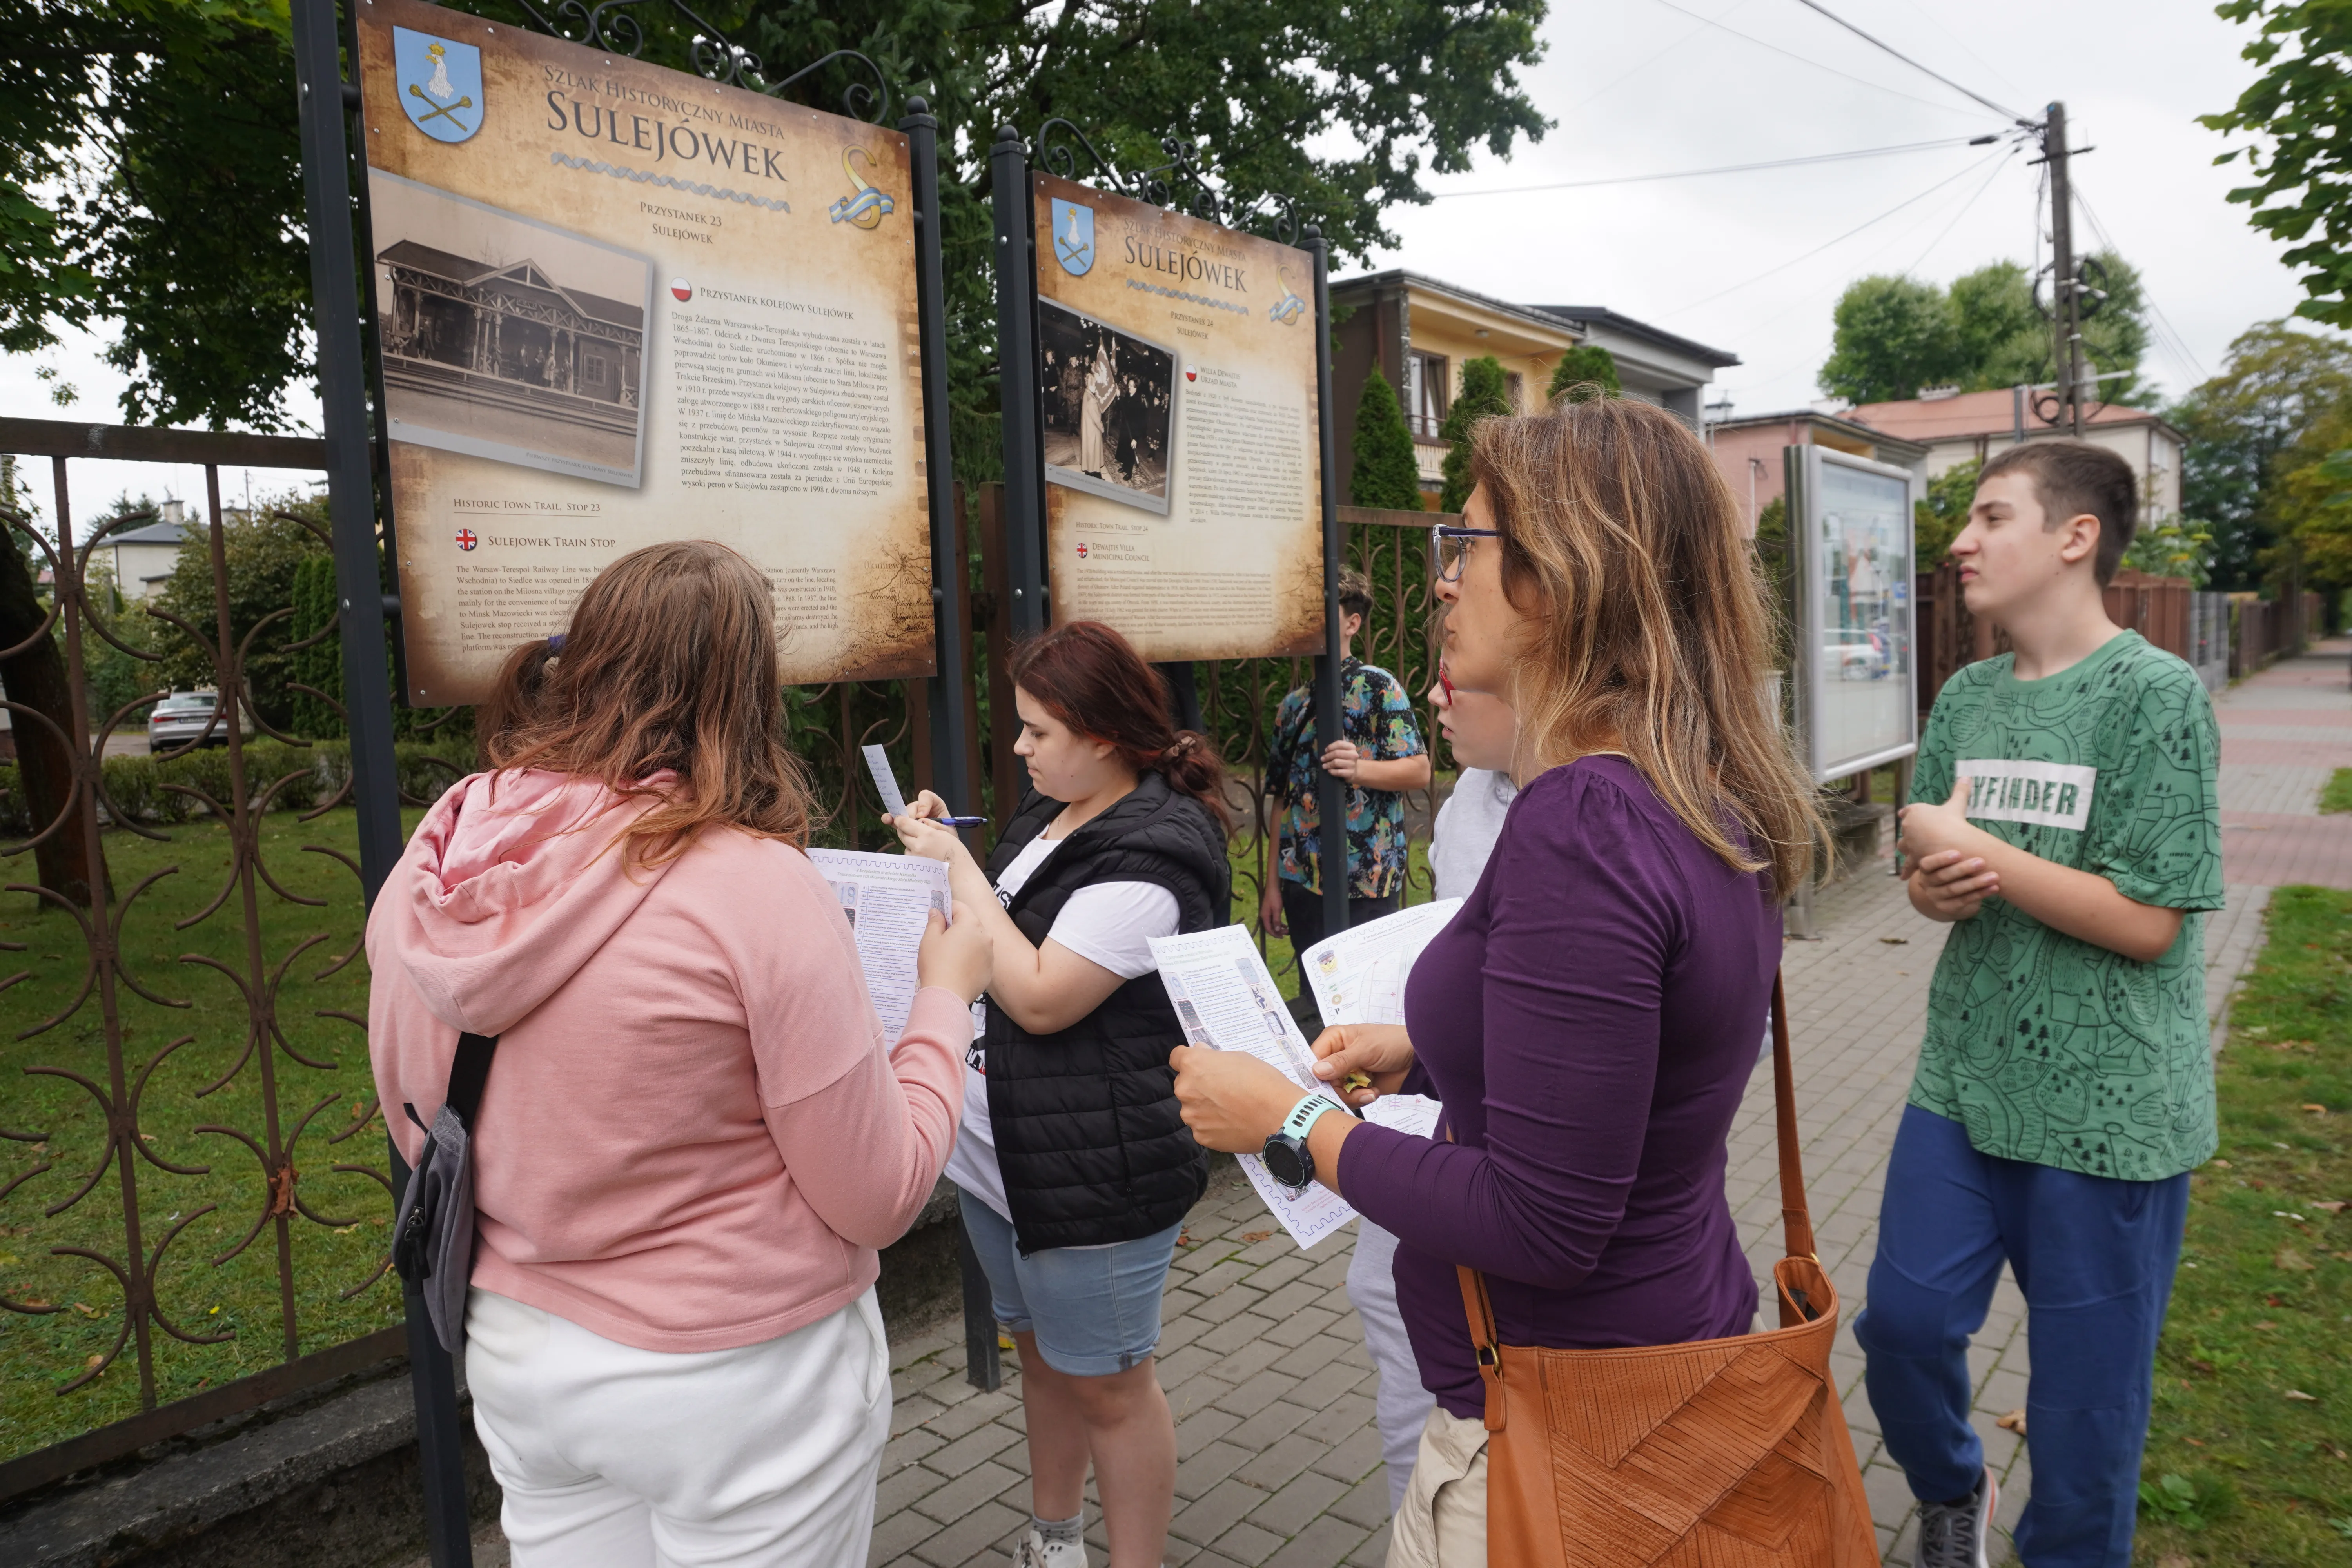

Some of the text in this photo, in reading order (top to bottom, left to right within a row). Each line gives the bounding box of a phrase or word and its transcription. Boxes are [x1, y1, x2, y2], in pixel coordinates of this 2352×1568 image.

[544, 64, 785, 140] SZLAK HISTORYCZNY MIASTA
[547, 90, 789, 181] SULEJÓWEK
[640, 201, 722, 227] PRZYSTANEK 23
[652, 223, 713, 244] SULEJÓWEK
[1124, 218, 1247, 262] SZLAK HISTORYCZNY MIASTA
[1125, 235, 1248, 293] SULEJÓWEK
[700, 287, 854, 320] PRZYSTANEK KOLEJOWY SULEJÓWEK
[671, 311, 693, 323] Droga
[695, 314, 721, 326] Żelazna
[723, 319, 800, 336] Warszawsko-Terespolska
[802, 331, 840, 342] wybudowana
[870, 340, 886, 348] latach
[1171, 311, 1214, 327] PRZYSTANEK 24
[673, 323, 711, 336] 1865–1867.
[714, 329, 742, 340] Odcinek
[751, 334, 776, 344] Dworca
[778, 338, 822, 352] Terespolskiego
[824, 345, 849, 354] (obecnie
[859, 349, 886, 359] Warszawa
[1177, 326, 1209, 339] SULEJÓWEK
[674, 349, 716, 359] poprowadzić
[740, 355, 754, 364] koło
[756, 358, 787, 368] Okuniewa
[794, 363, 822, 372] wykonała
[824, 367, 842, 376] zakręt
[843, 368, 856, 377] linii,
[858, 370, 887, 381] lokalizując
[1200, 366, 1216, 375] WILLA
[675, 371, 701, 381] Trakcie
[702, 374, 737, 386] Brzeskim).
[739, 378, 772, 389] Przystanek
[773, 382, 801, 394] kolejowy
[809, 386, 840, 396] Sulejówku
[841, 390, 872, 401] zbudowany
[679, 431, 717, 443] konstrukcje
[720, 435, 736, 443] wiat,
[739, 437, 772, 446] przystanek
[783, 439, 815, 449] Sulejówku
[817, 443, 842, 452] otrzymał
[845, 445, 866, 454] stylowy
[869, 446, 892, 455] budynek
[682, 479, 705, 488] wysoki
[735, 481, 768, 491] Sulejówku
[769, 484, 801, 493] zastąpiono
[831, 486, 851, 494] dwoma
[853, 488, 878, 497] niższymi.
[454, 499, 600, 512] HISTORIC TOWN TRAIL, STOP 23
[488, 535, 615, 547] SULEJOWEK TRAIN STOP
[472, 566, 530, 574] Warsaw-Terespol
[533, 566, 559, 574] Railway
[549, 577, 572, 585] opened
[458, 599, 482, 608] mainly
